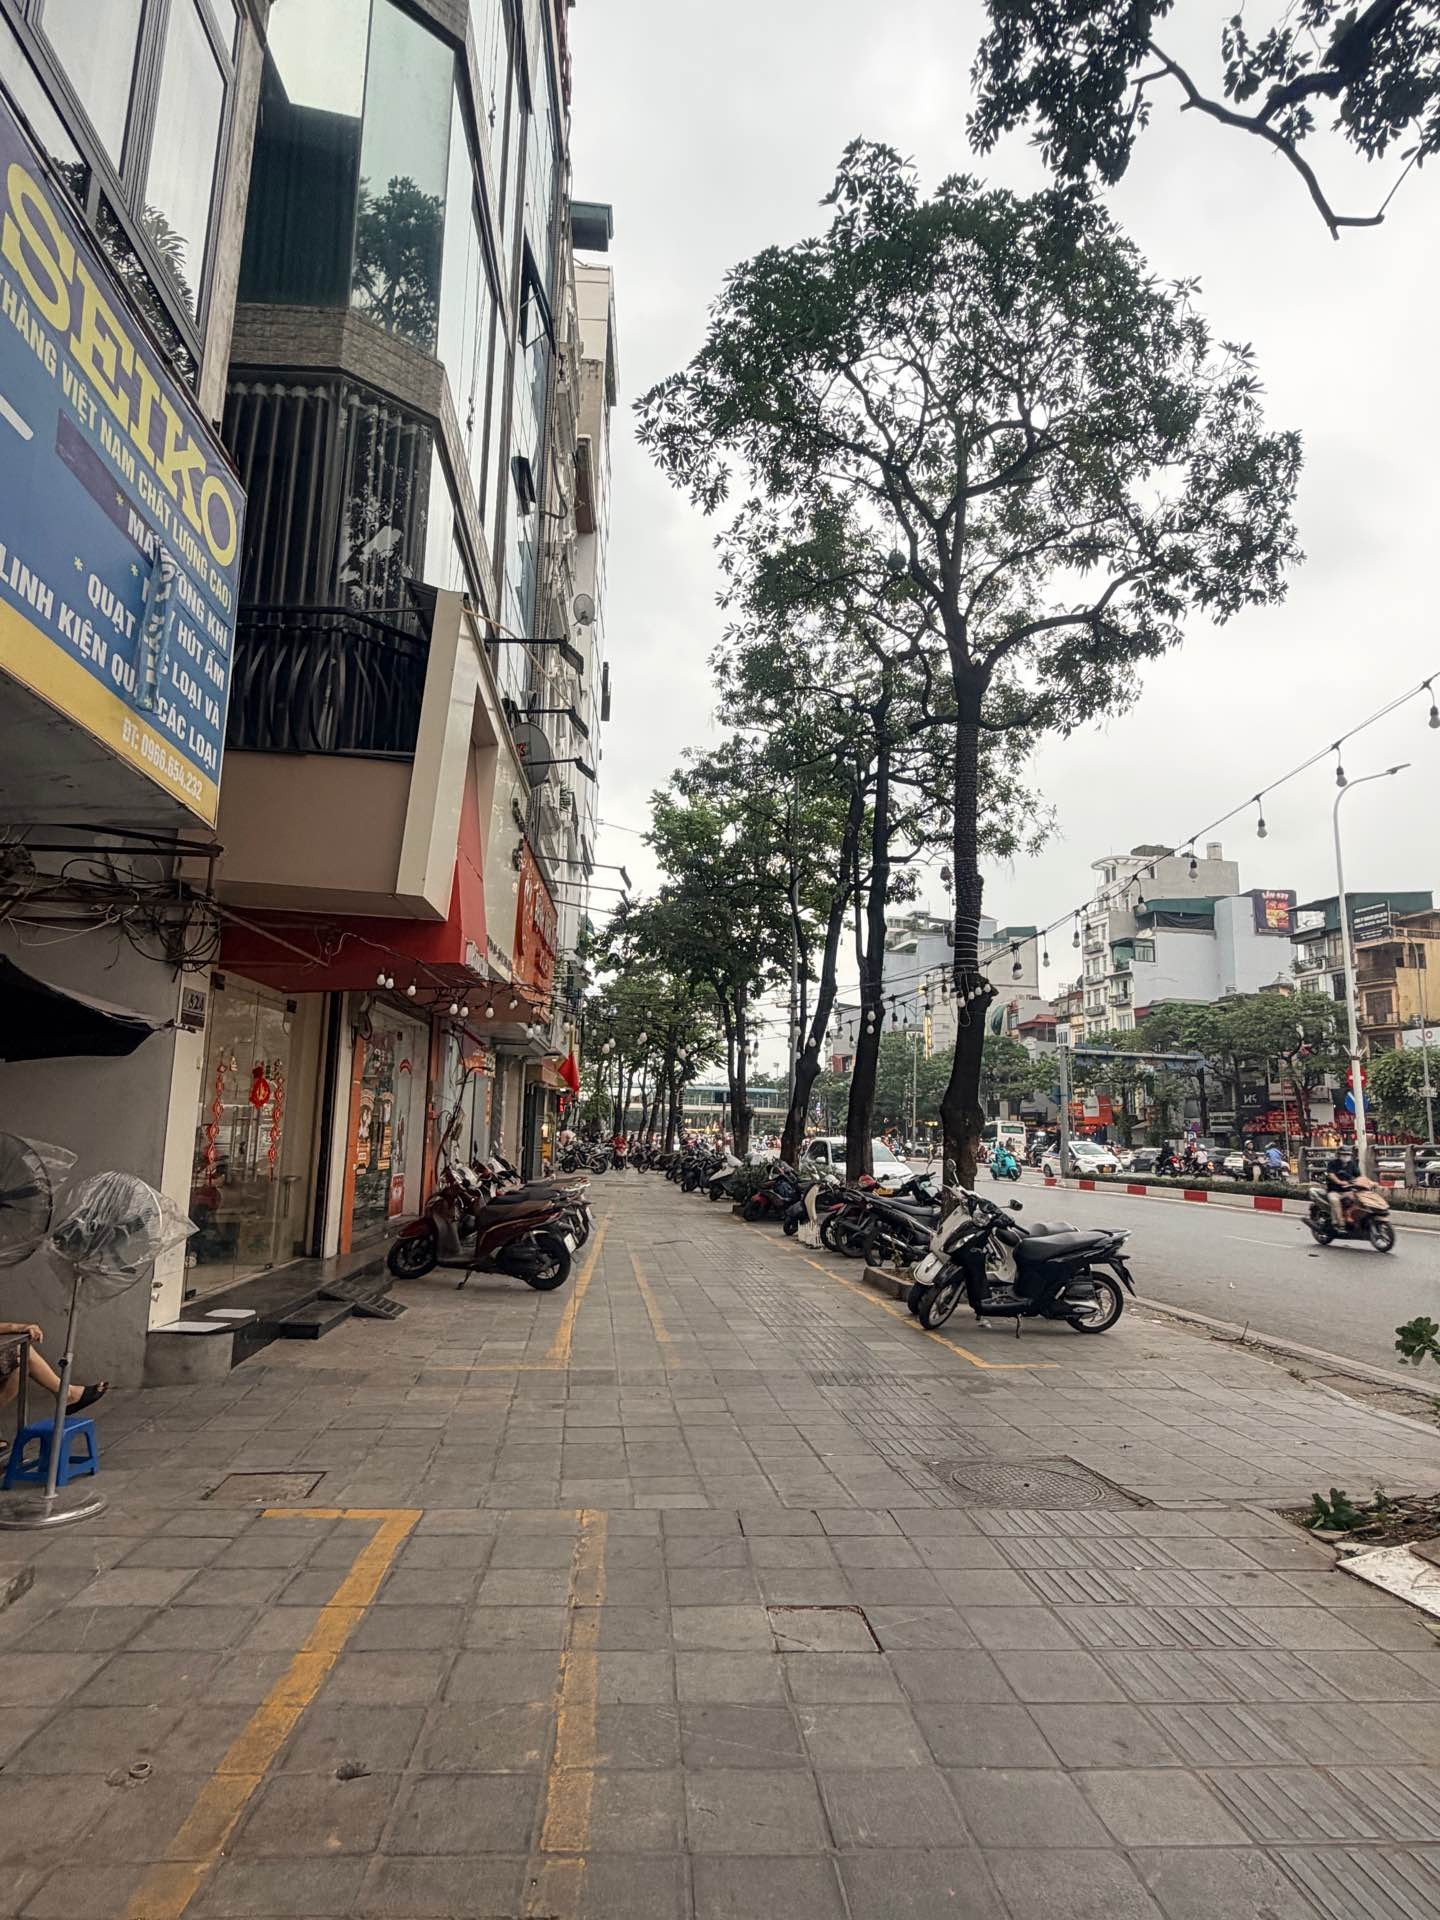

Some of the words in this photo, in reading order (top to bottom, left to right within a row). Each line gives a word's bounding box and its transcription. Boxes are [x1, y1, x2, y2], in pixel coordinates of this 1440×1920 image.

[1, 162, 237, 566] SEIKO
[62, 360, 98, 429] VIỆT
[101, 416, 135, 483] NAM
[138, 469, 172, 530] CHẤT
[172, 516, 208, 583] LƯỢNG
[209, 568, 232, 614] CAO)
[0, 542, 54, 620] LINH
[57, 602, 108, 669] KIỆN
[157, 696, 187, 740] CÁC
[188, 725, 218, 771] LOẠI
[87, 573, 136, 639] QUẠT
[171, 661, 202, 711] LOẠI
[204, 695, 220, 730] VÀ
[177, 619, 204, 665] HÚT
[204, 649, 225, 692] ẨM
[207, 610, 228, 651] KHÍ
[122, 717, 140, 751] ĐT:
